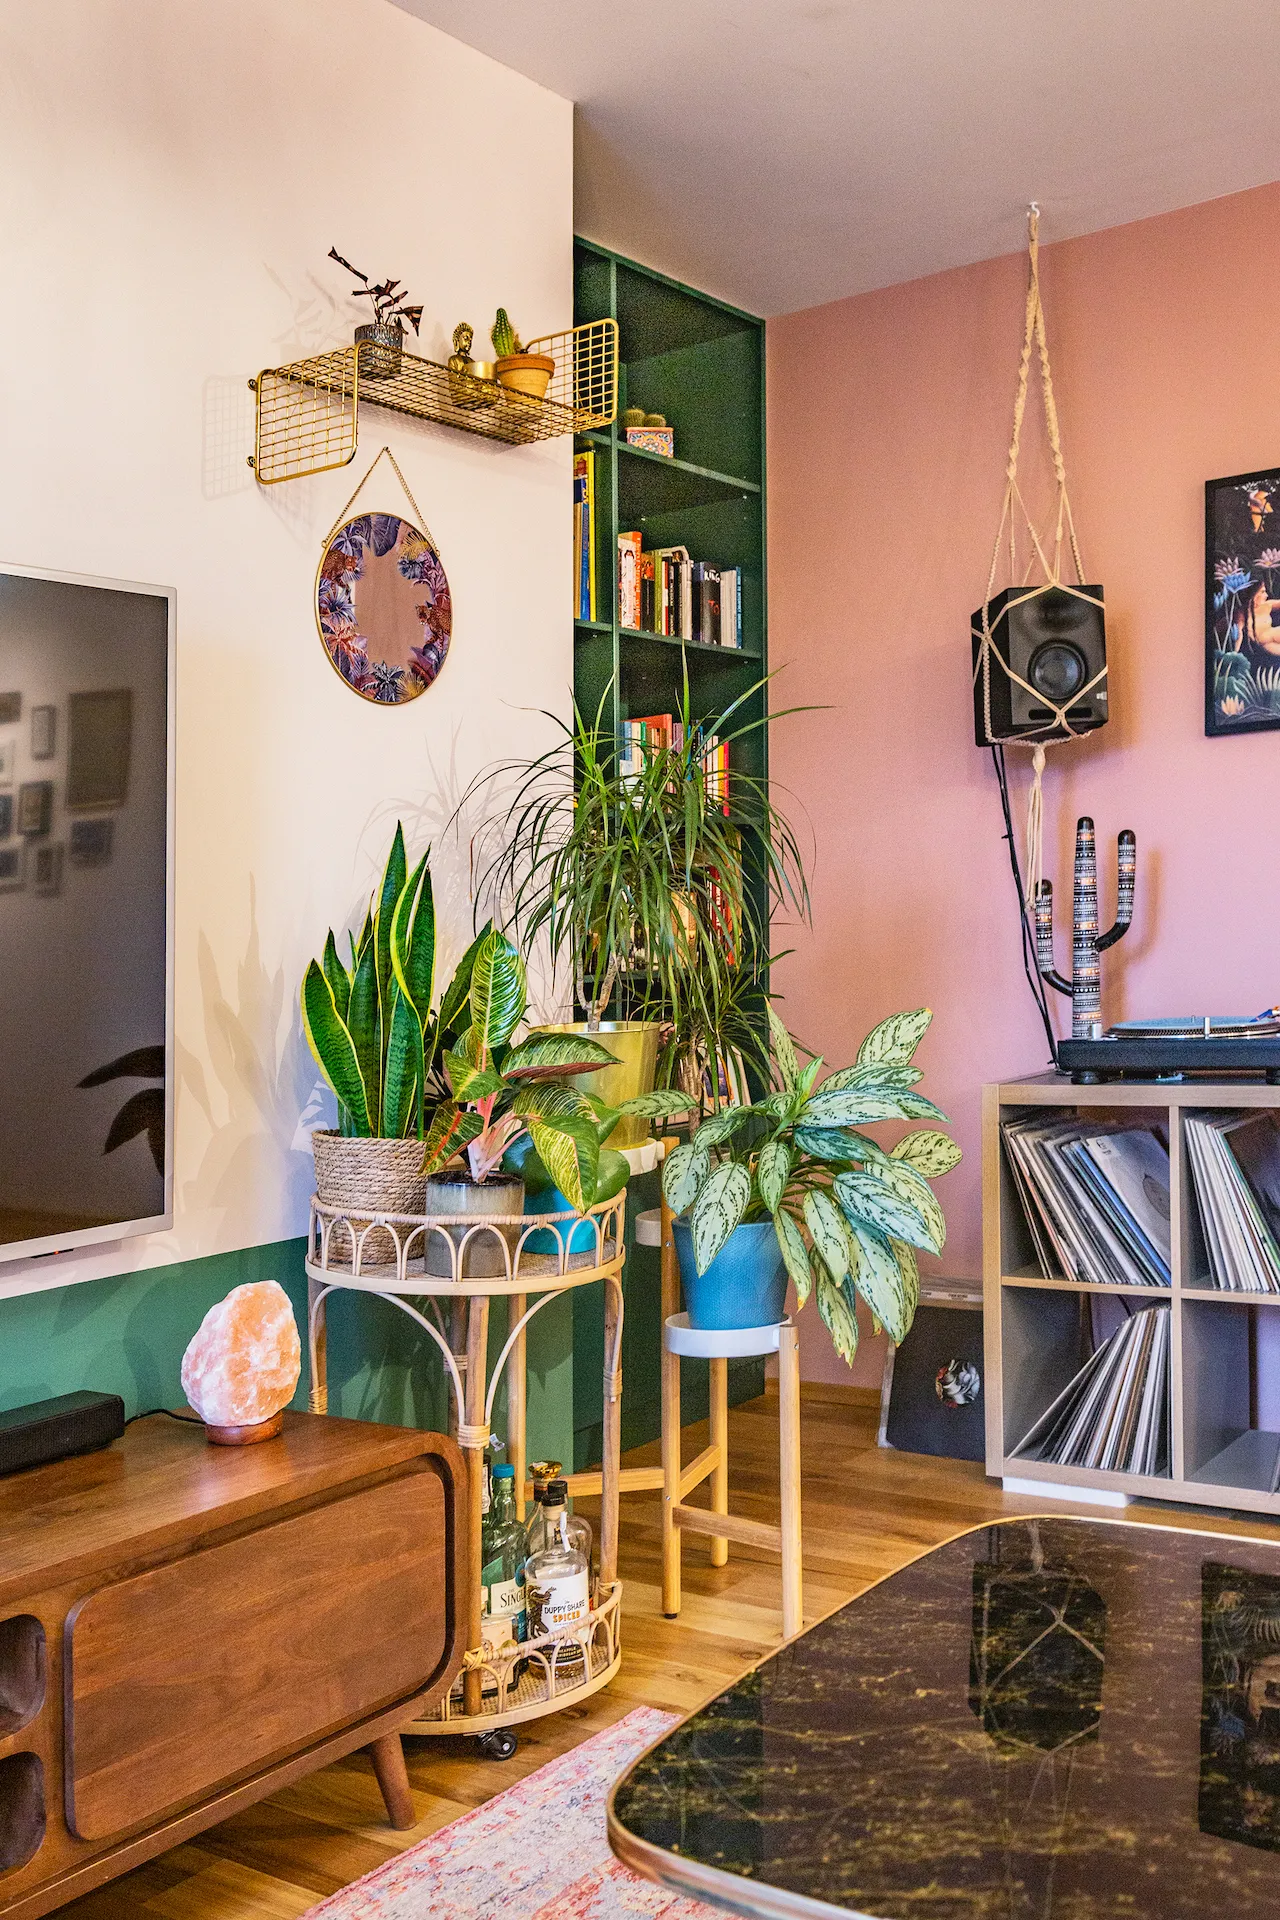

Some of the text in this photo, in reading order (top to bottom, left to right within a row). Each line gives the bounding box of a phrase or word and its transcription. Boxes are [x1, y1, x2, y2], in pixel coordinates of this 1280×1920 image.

[704, 569, 720, 583] KING
[544, 1599, 585, 1615] DUPPY SHARE
[553, 1610, 580, 1624] SPICED
